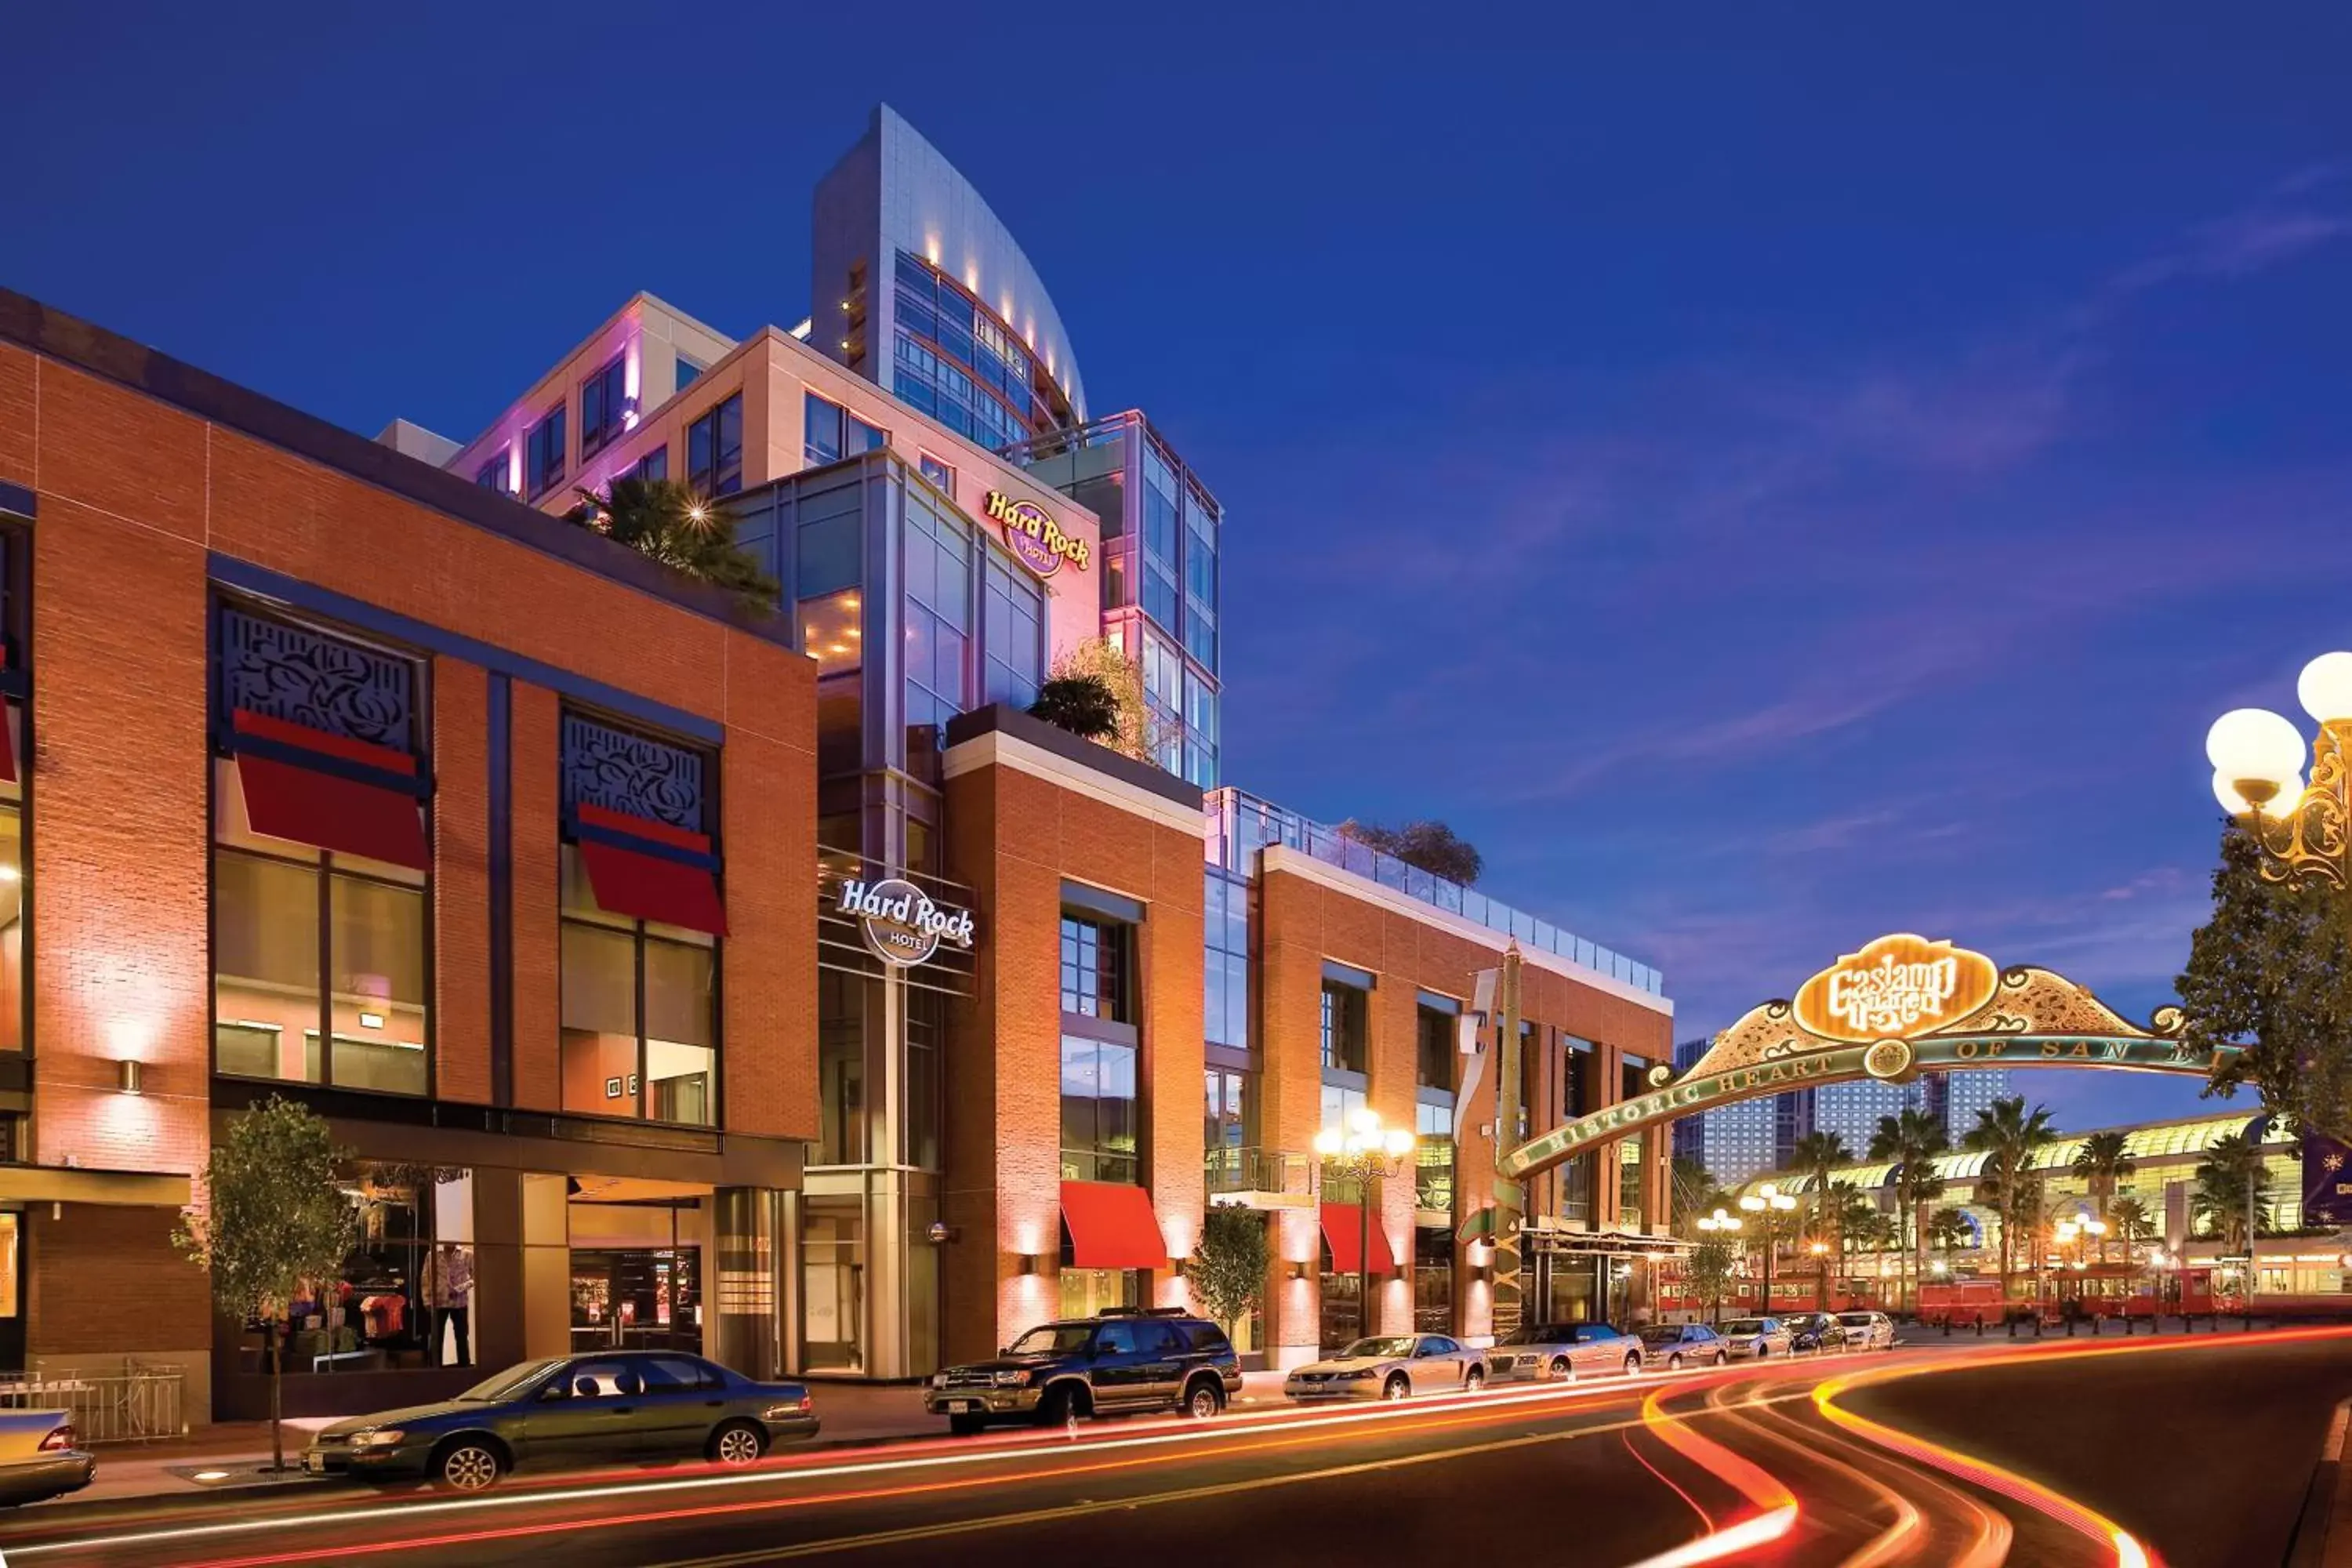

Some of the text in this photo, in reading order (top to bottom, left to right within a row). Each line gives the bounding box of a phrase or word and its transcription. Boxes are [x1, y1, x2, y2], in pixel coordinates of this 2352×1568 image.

[988, 490, 1090, 570] Hard Rock
[840, 879, 975, 946] Hard Rock
[890, 931, 928, 952] HOTEL
[1828, 954, 1957, 1017] Gaslamp
[1550, 1084, 1700, 1150] HISTORIC
[1719, 1056, 1835, 1093] HEART
[1956, 1040, 2007, 1058] OF
[2042, 1040, 2131, 1062] SAN
